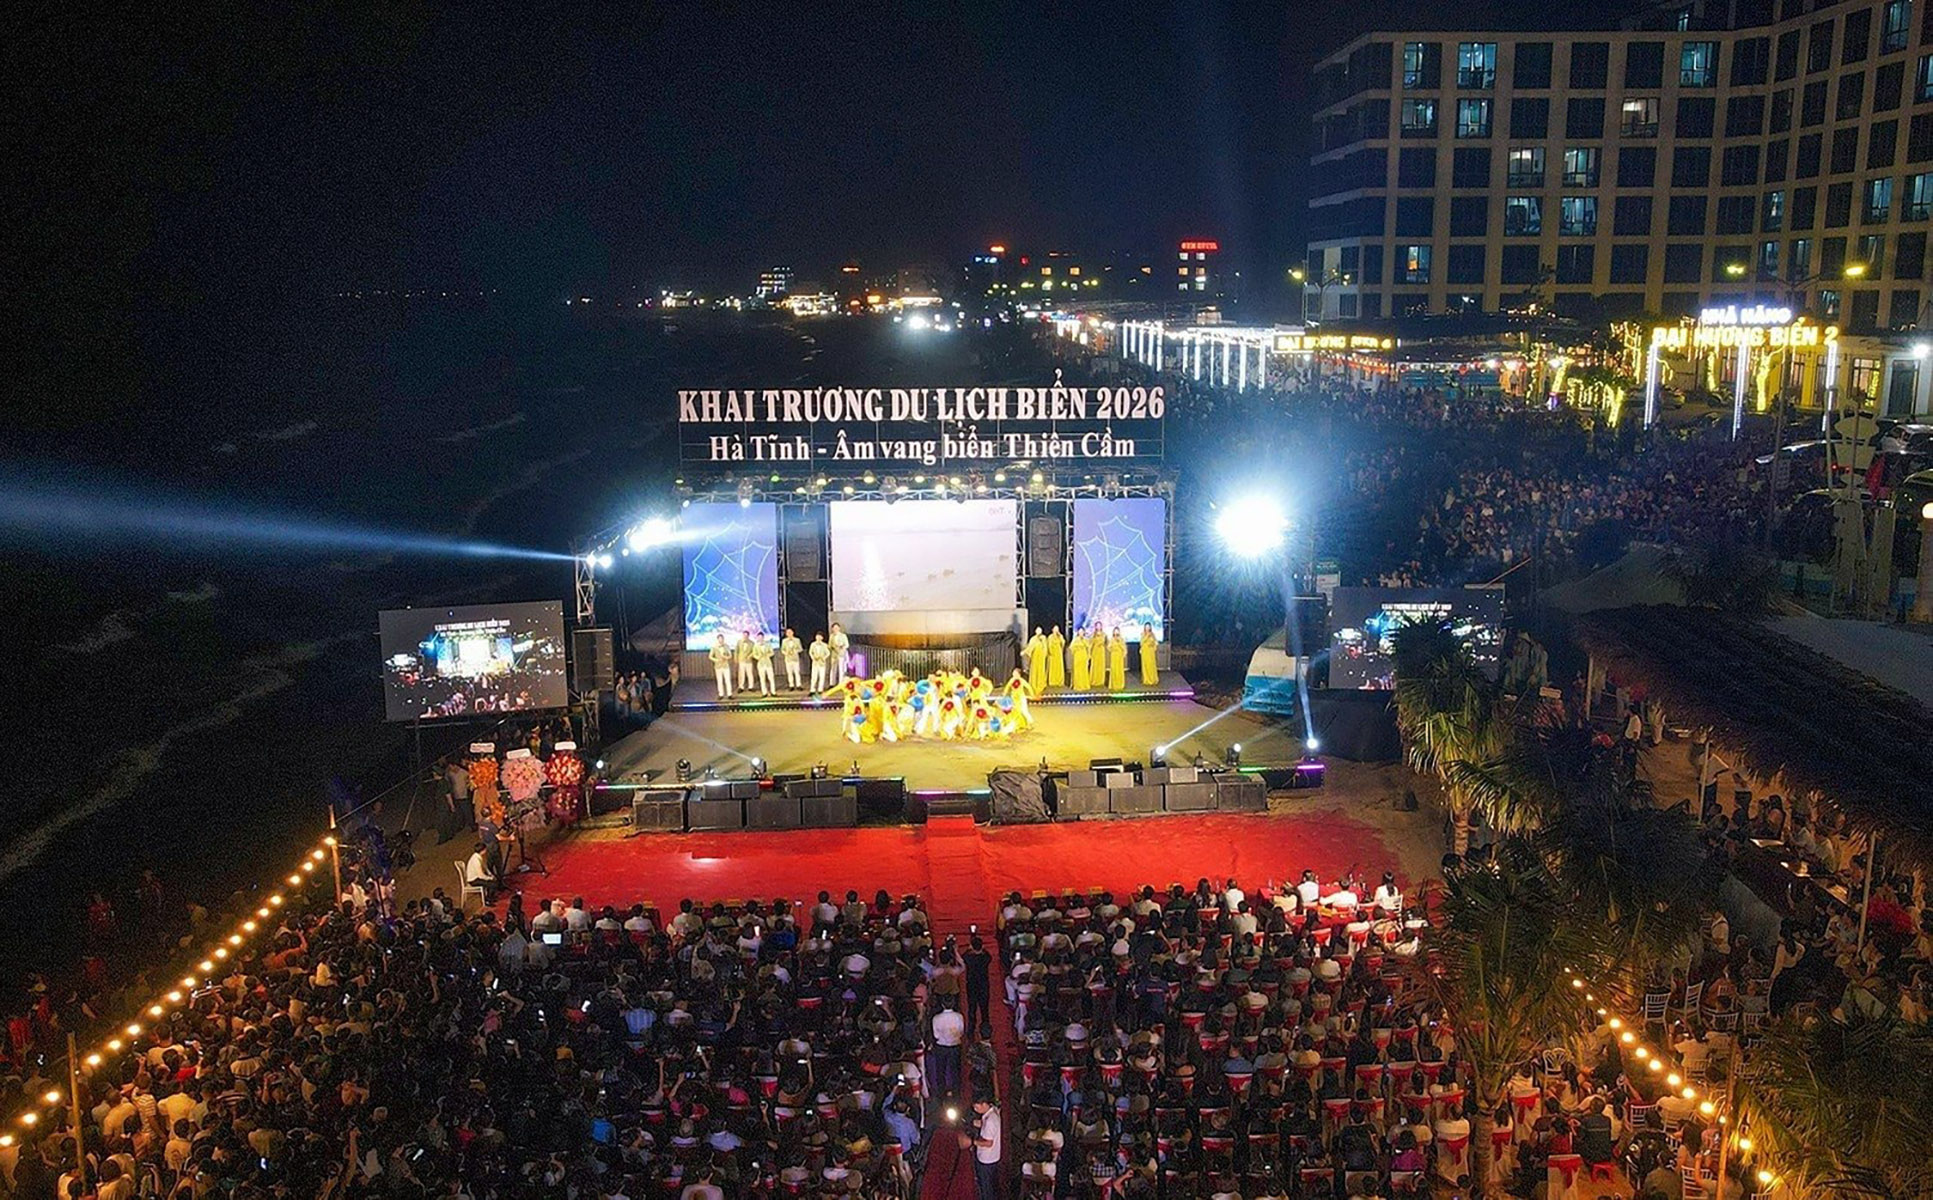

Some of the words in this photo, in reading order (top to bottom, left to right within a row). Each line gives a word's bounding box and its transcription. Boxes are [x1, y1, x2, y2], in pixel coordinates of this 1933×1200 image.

[1824, 326, 1840, 346] 2
[678, 389, 756, 422] KHAI
[762, 386, 883, 422] TRƯƠNG
[890, 388, 930, 421] DU
[935, 387, 1008, 428] LỊCH
[1016, 368, 1088, 420] BIỂN
[1095, 386, 1165, 419] 2026
[709, 434, 744, 461] Hà
[750, 433, 811, 461] Tĩnh
[832, 429, 875, 460] Âm
[879, 440, 937, 465] vang
[943, 425, 994, 458] biển
[1003, 431, 1073, 458] Thiên
[1081, 427, 1135, 457] Cầm
